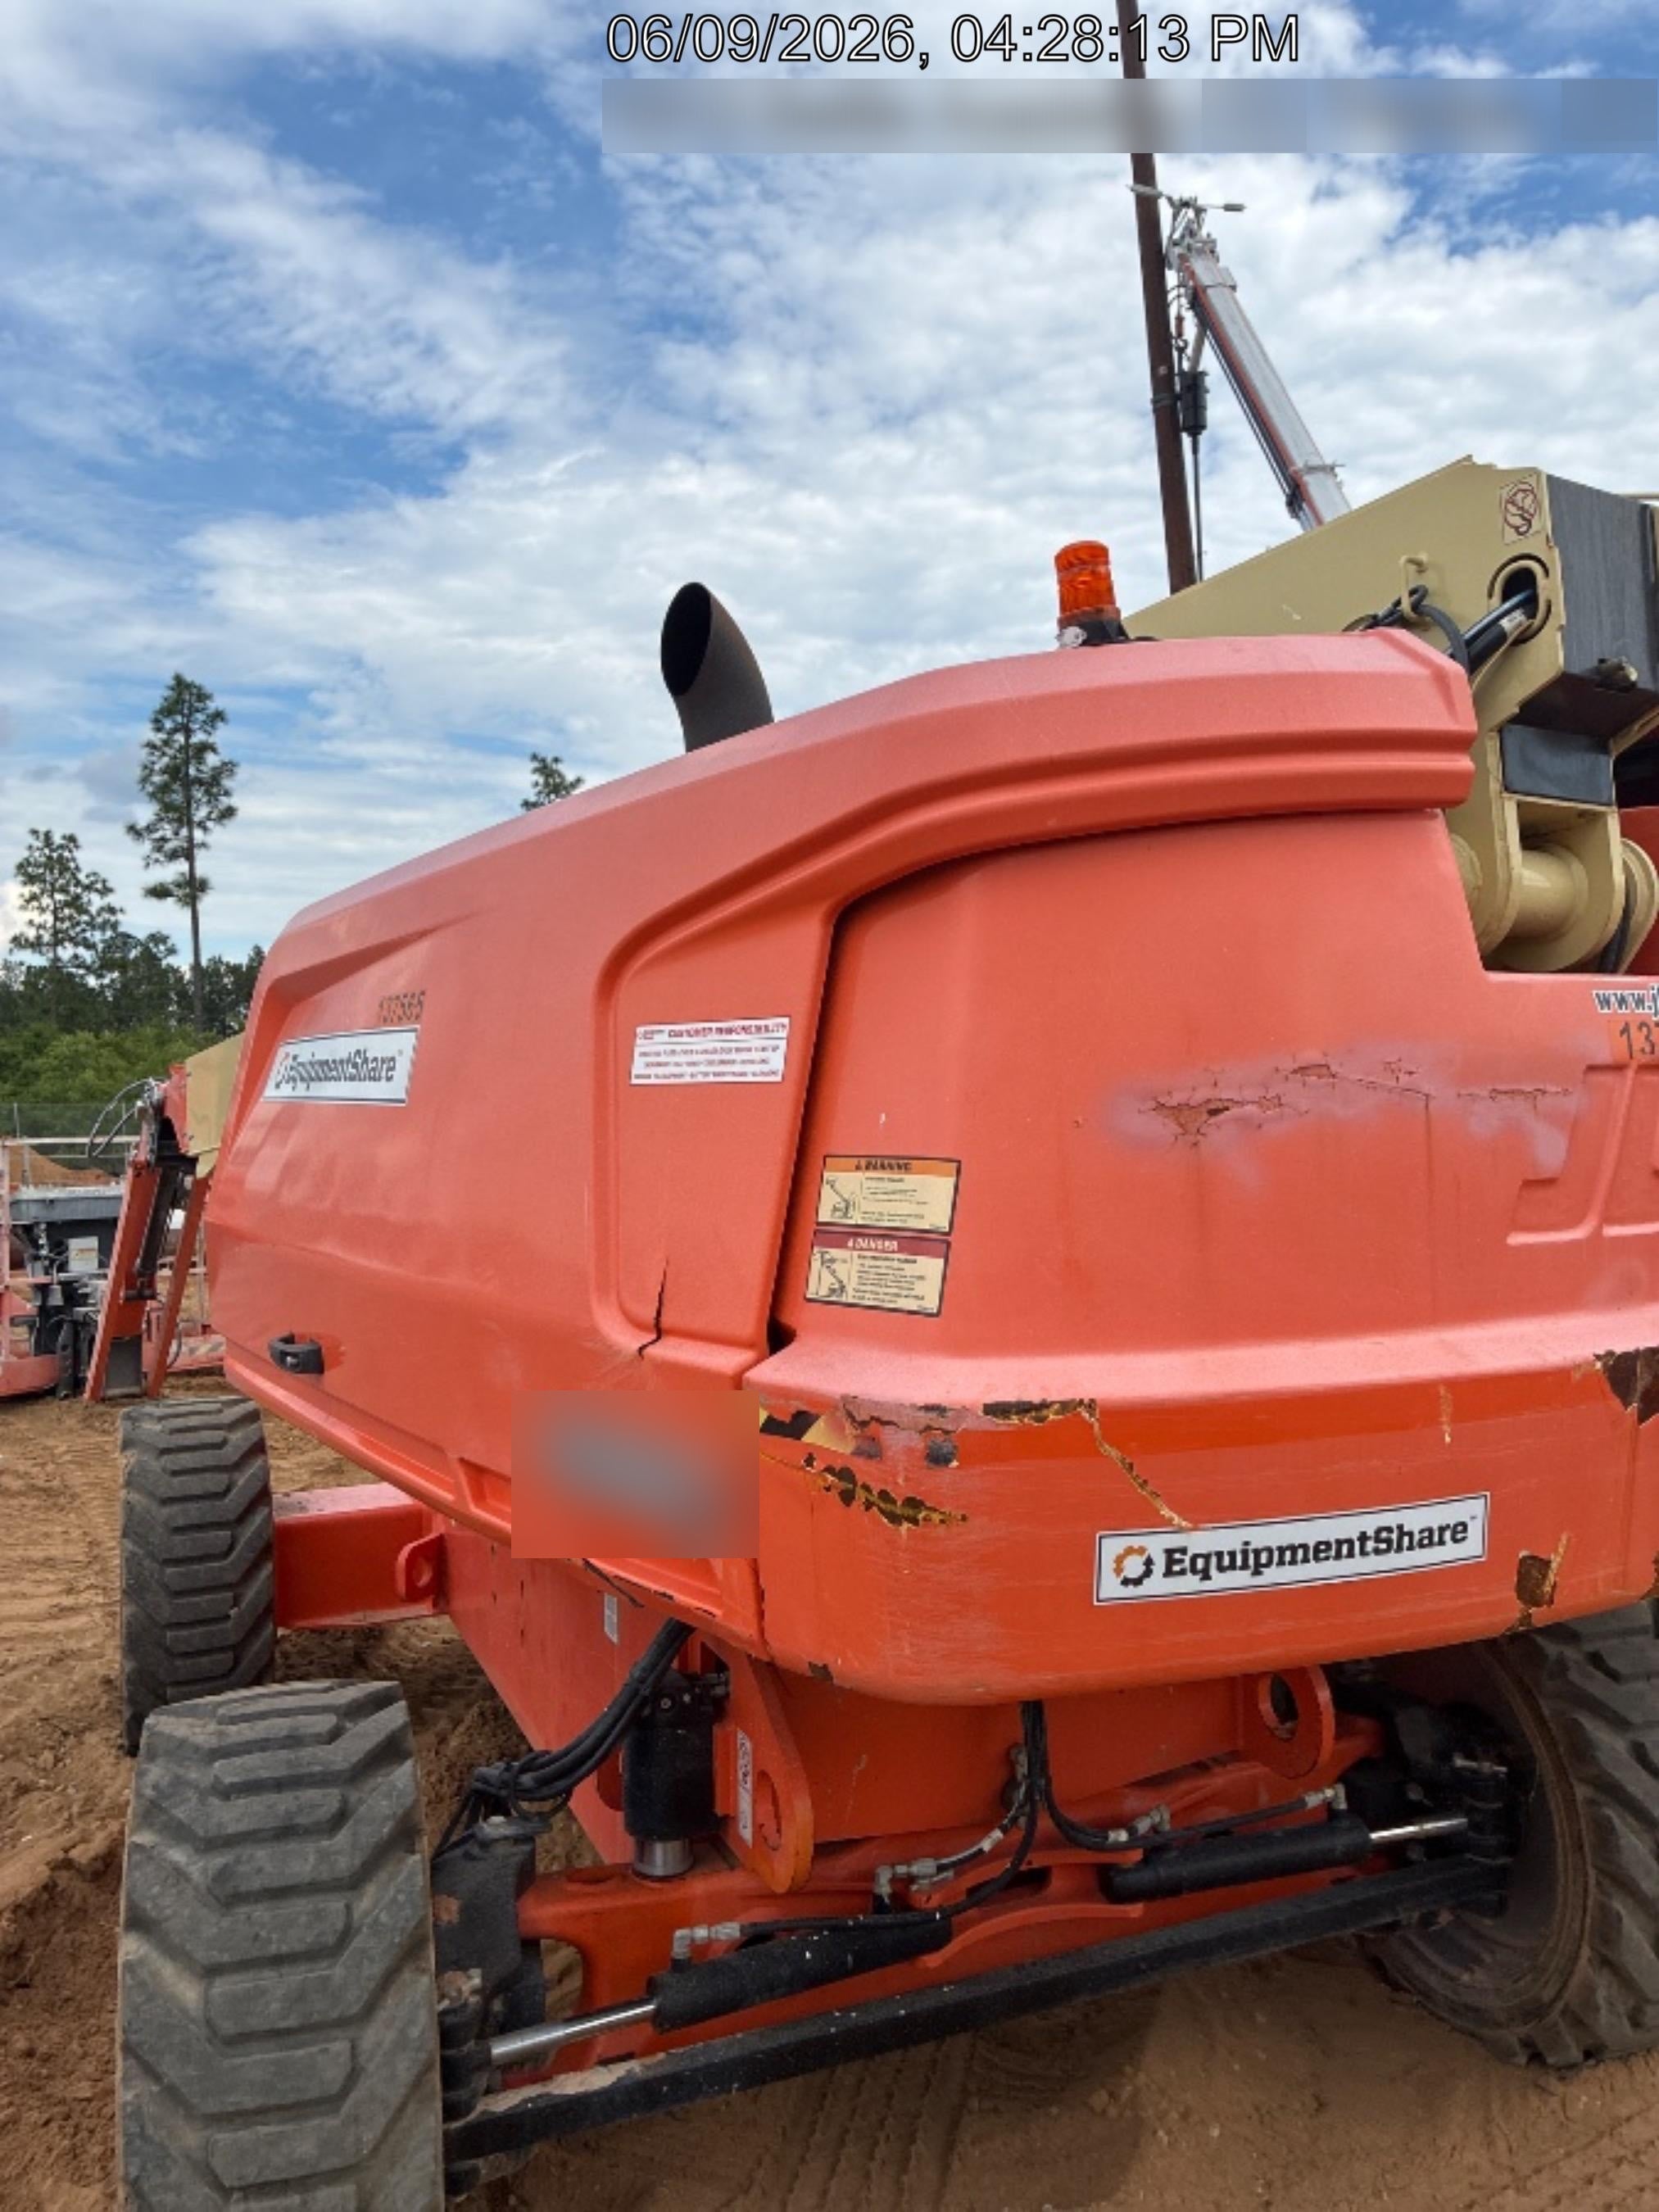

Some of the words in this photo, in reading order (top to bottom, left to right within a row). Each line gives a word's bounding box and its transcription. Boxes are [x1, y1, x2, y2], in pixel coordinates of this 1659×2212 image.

[1594, 985, 1659, 1018] www.j
[1619, 1022, 1659, 1059] 13
[284, 1049, 397, 1091] EquipmentShare
[1162, 1520, 1469, 1581] EquipmentShare
